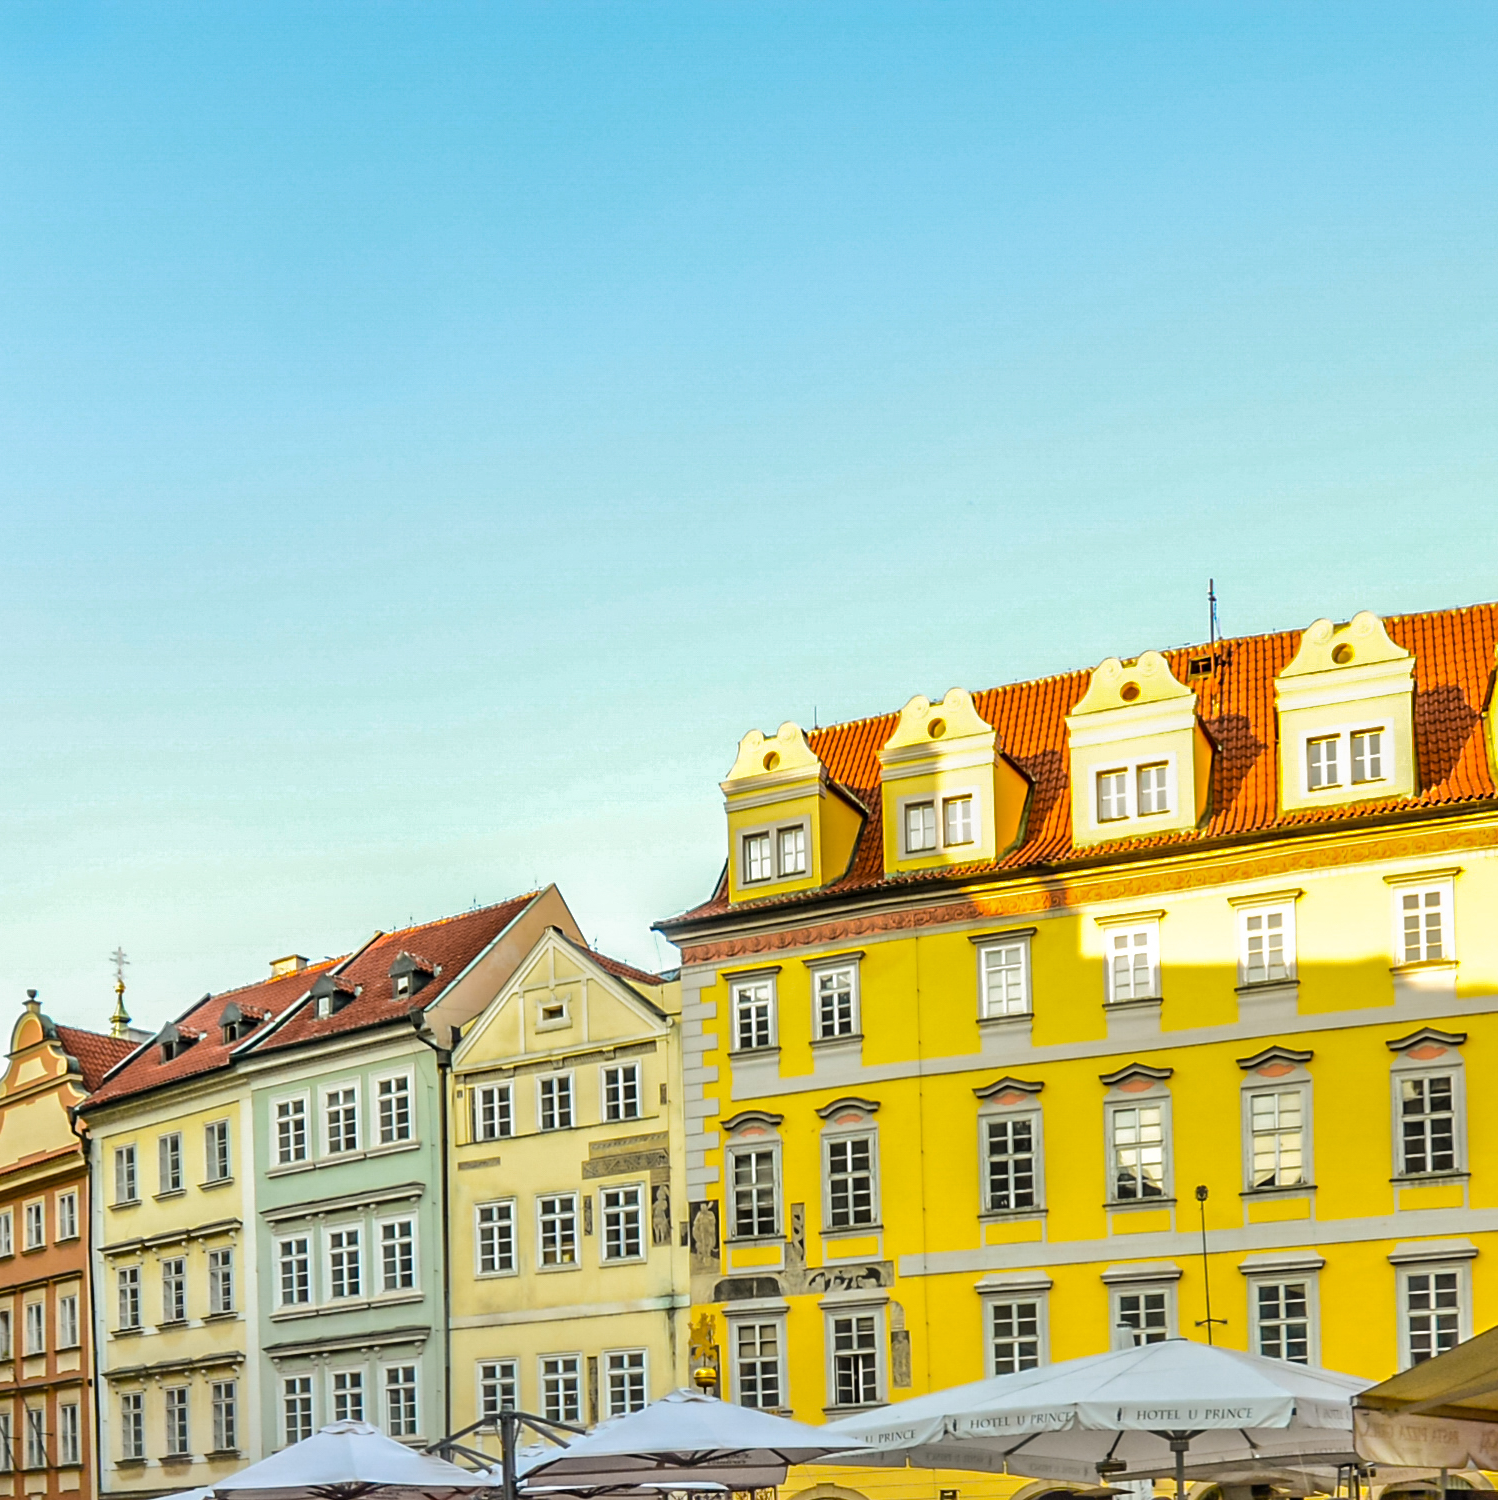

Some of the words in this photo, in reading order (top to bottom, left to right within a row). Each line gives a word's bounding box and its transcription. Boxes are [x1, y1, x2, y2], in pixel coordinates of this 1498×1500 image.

[970, 1416, 1009, 1430] HOTEL
[1017, 1415, 1026, 1426] U
[1029, 1411, 1073, 1425] PRINCE
[1136, 1409, 1181, 1421] HOTEL
[1189, 1409, 1198, 1420] U
[1204, 1407, 1253, 1420] PRINCE
[878, 1429, 916, 1443] PRINCE
